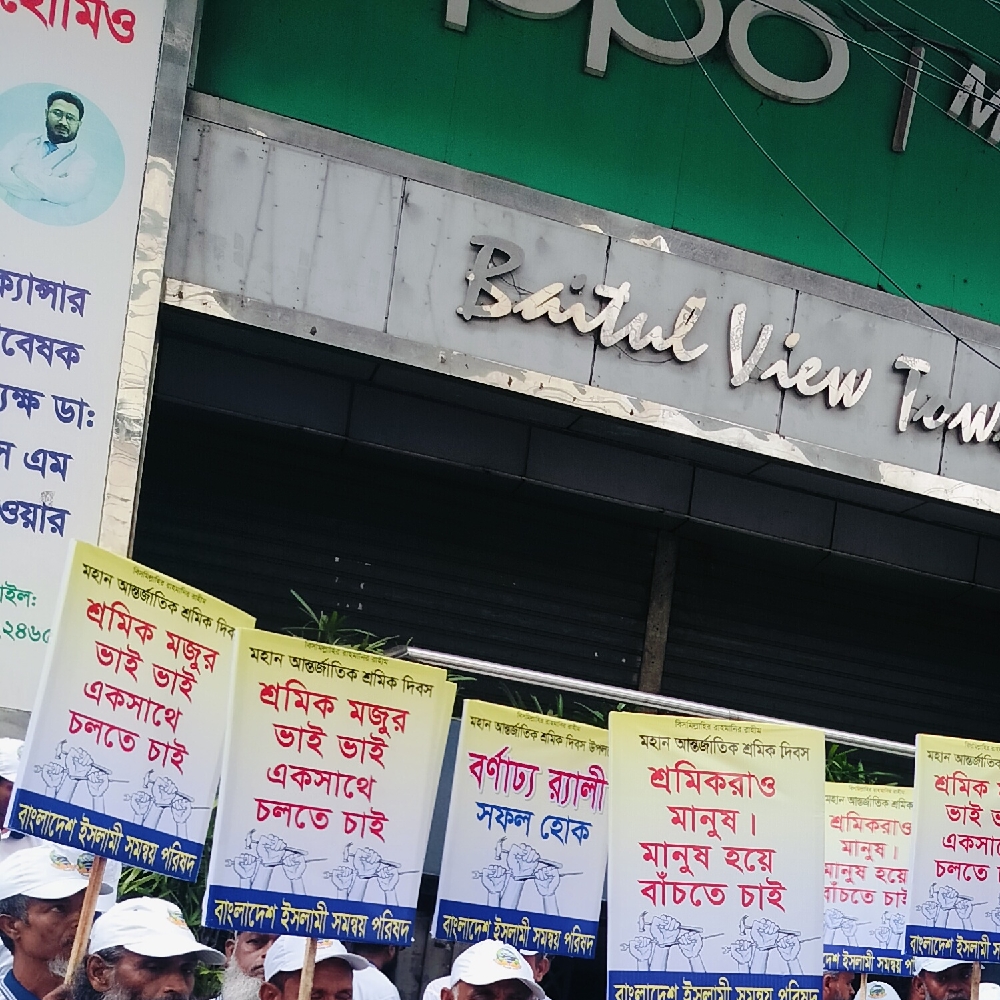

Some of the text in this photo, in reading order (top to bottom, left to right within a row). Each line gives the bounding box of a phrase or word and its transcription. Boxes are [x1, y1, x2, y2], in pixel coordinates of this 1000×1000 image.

[456, 234, 709, 363] Baitul
[729, 303, 872, 409] View
[24, 447, 73, 482] এম
[86, 598, 158, 646] শ্রমিক
[165, 629, 221, 674] মজুর
[95, 640, 199, 704] ভাই ভাই
[83, 680, 184, 734] একসাথে
[258, 678, 411, 740] শ্রমিক মজুর
[68, 709, 190, 776] চলতে চাই
[272, 720, 390, 770] ভাই ভাই
[266, 763, 378, 803] একসাথে
[468, 745, 609, 813] বর্ণাঢ্য র‍্যালী
[647, 759, 777, 799] শ্রমিকরাও
[933, 770, 990, 799] শ্রমিক
[254, 797, 390, 843] চলতে চাই
[475, 801, 593, 847] সফল হোক
[667, 805, 741, 841] মানুষ
[945, 801, 984, 828] ভাই
[638, 841, 778, 878] মানুষ হয়ে
[934, 859, 991, 882] চলতে
[637, 870, 788, 913] বাঁচতে চাই
